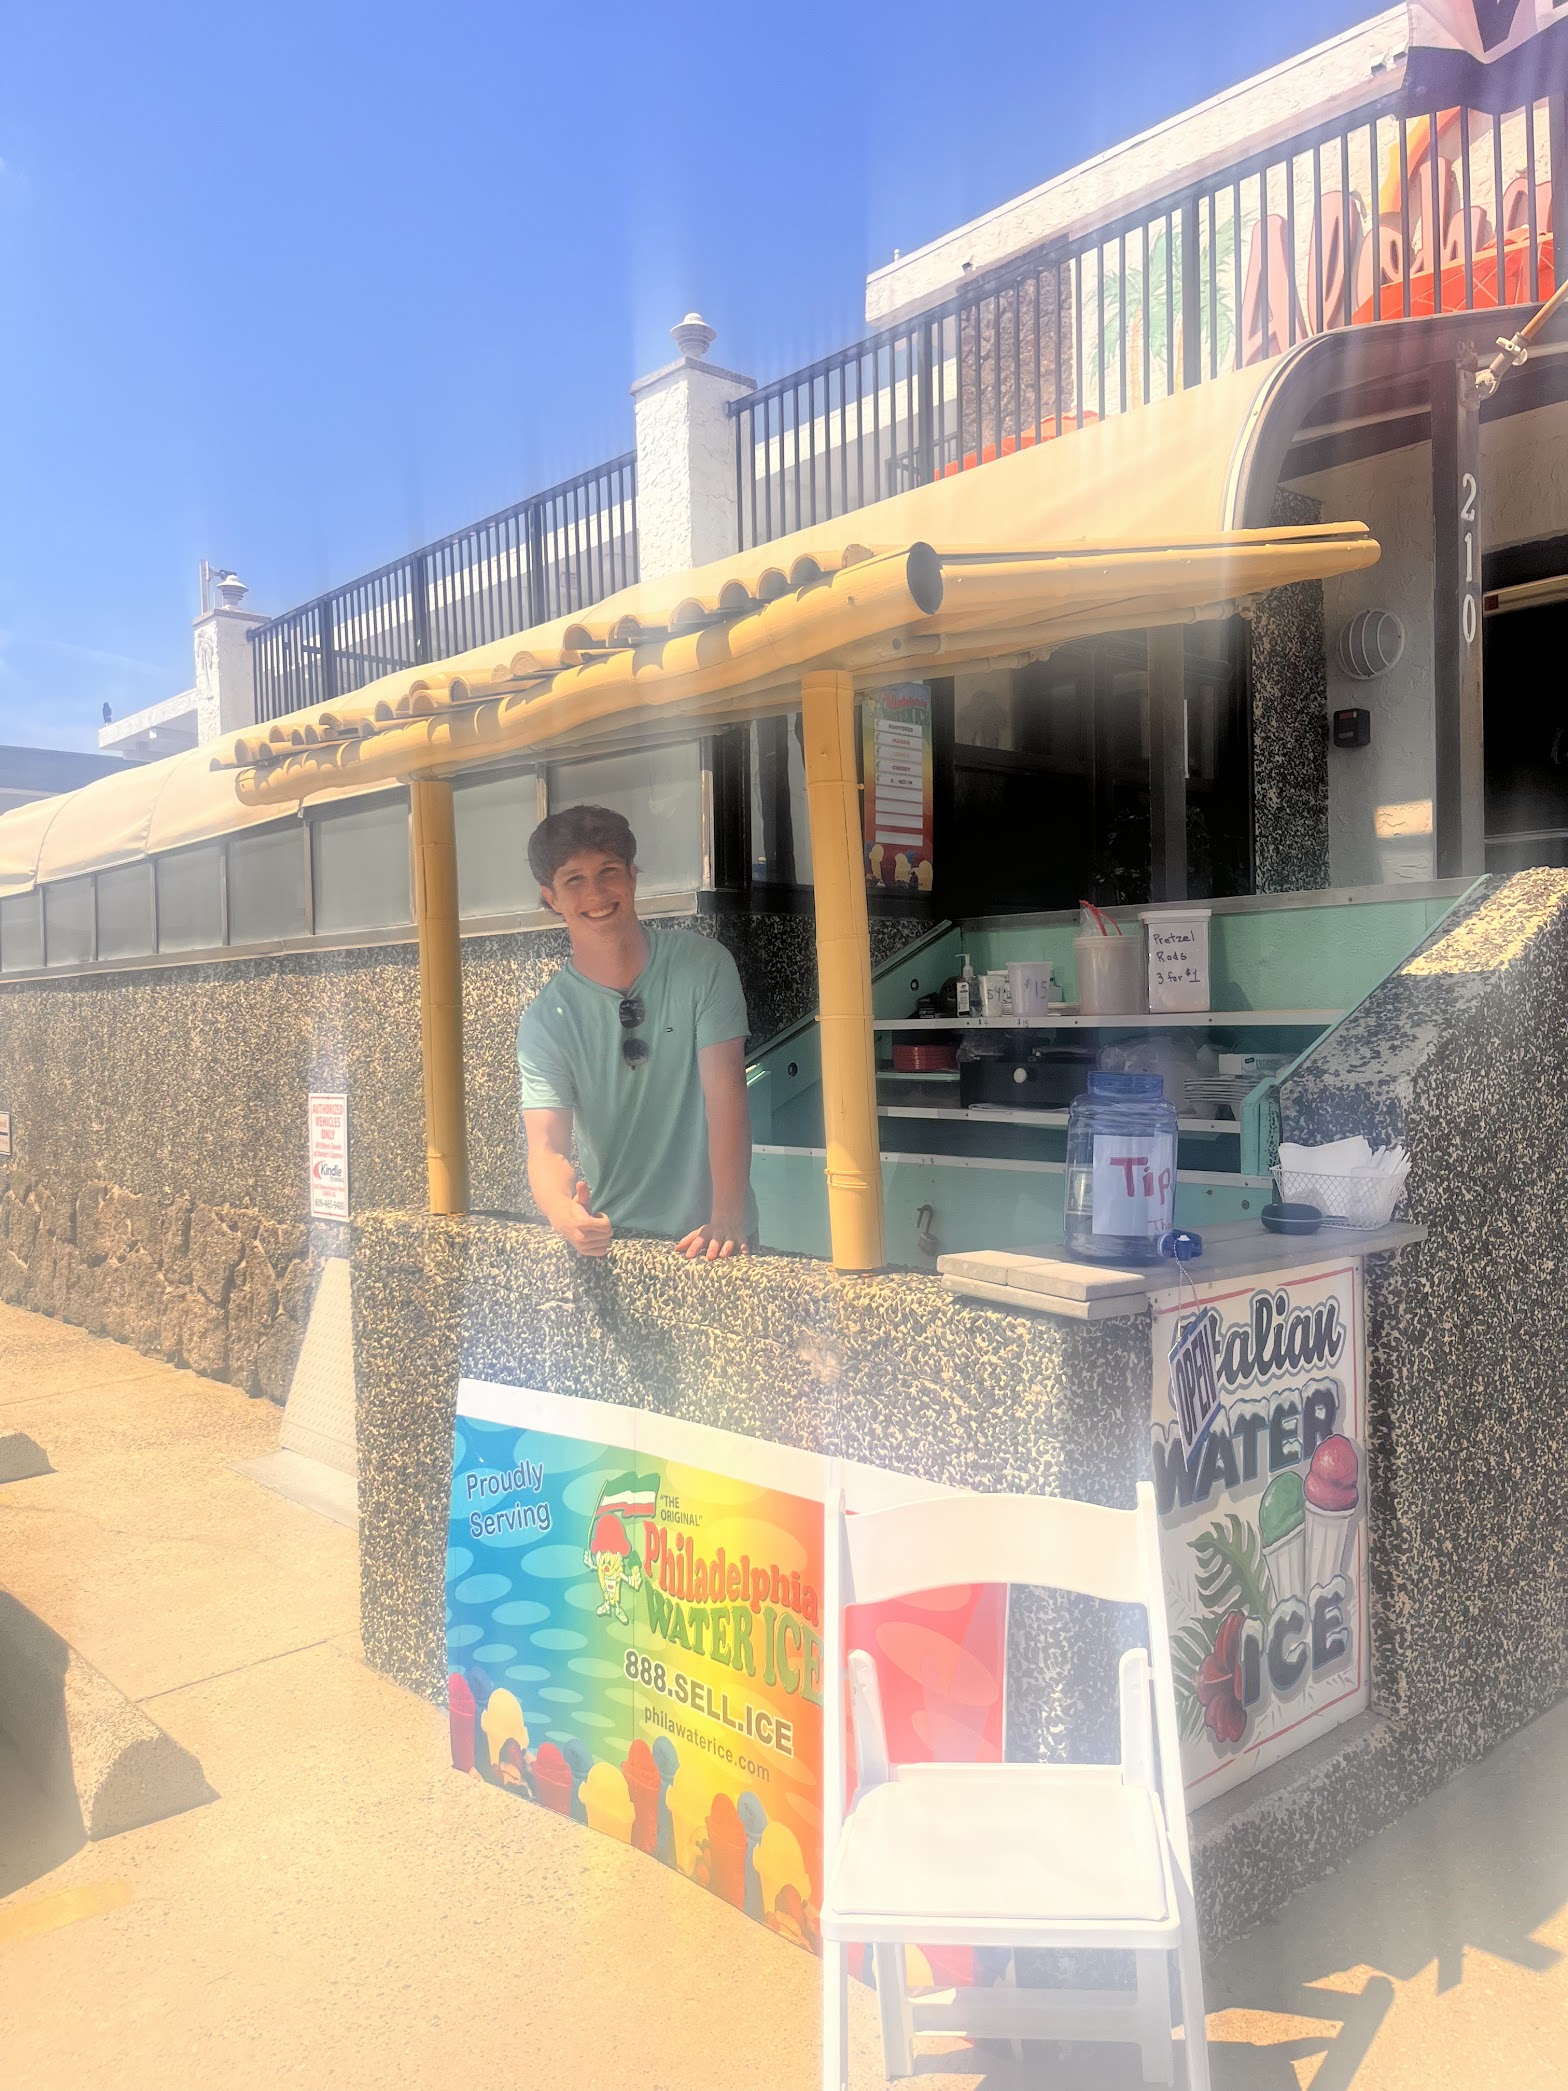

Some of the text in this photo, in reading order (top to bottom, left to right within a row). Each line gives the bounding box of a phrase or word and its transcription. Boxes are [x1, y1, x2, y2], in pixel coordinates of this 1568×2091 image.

[1460, 472, 1477, 643] 210
[1153, 930, 1195, 944] Pretzel
[1156, 951, 1187, 962] Rods
[1156, 967, 1201, 984] 3 for $1
[312, 1103, 343, 1116] AUTHORIZED
[315, 1116, 341, 1128] VEHICLES
[321, 1129, 335, 1140] ONLY
[320, 1163, 342, 1177] Kindle
[1110, 1156, 1172, 1206] Tip
[1175, 1322, 1218, 1447] OPEN
[1151, 1378, 1340, 1515] WATER
[466, 1459, 544, 1500] Proudly
[470, 1502, 551, 1538] Serving
[643, 1520, 819, 1627] Philadelphia
[644, 1577, 824, 1709] WATER ICE
[1239, 1575, 1349, 1708] ICE
[624, 1650, 794, 1757] 888.SELL.ICE
[644, 1704, 771, 1783] philawaterice.com
